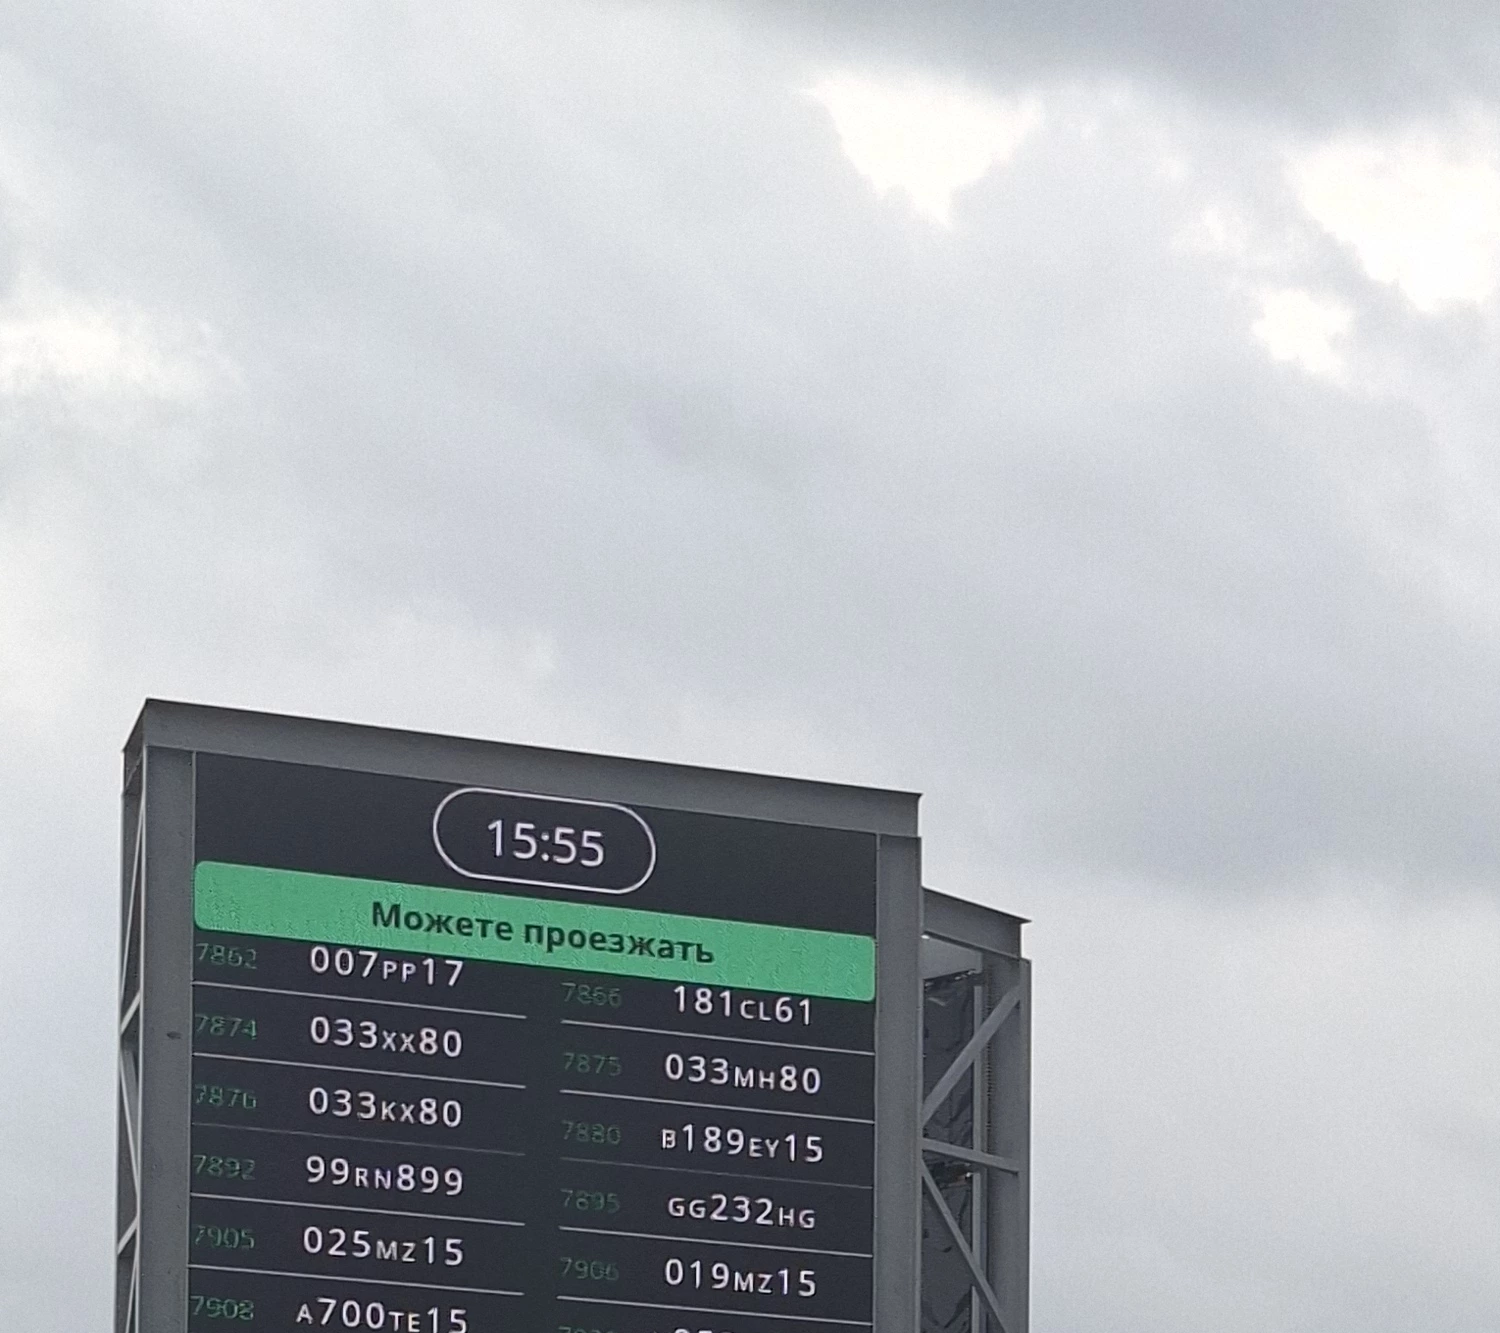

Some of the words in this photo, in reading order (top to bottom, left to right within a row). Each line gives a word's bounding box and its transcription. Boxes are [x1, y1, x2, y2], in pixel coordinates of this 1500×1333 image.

[488, 819, 604, 867] 15:55
[372, 901, 513, 942] Можете
[524, 922, 715, 965] проезжать
[310, 945, 464, 987] 007PP17
[674, 985, 810, 1025] 181CL61
[665, 1053, 821, 1094] 033MH80
[662, 1124, 823, 1163] B189EY15
[306, 1155, 463, 1196] 99RN899
[668, 1193, 815, 1229] GG232HG
[303, 1226, 463, 1266] 025MZ15
[665, 1258, 816, 1297] 019MZ15
